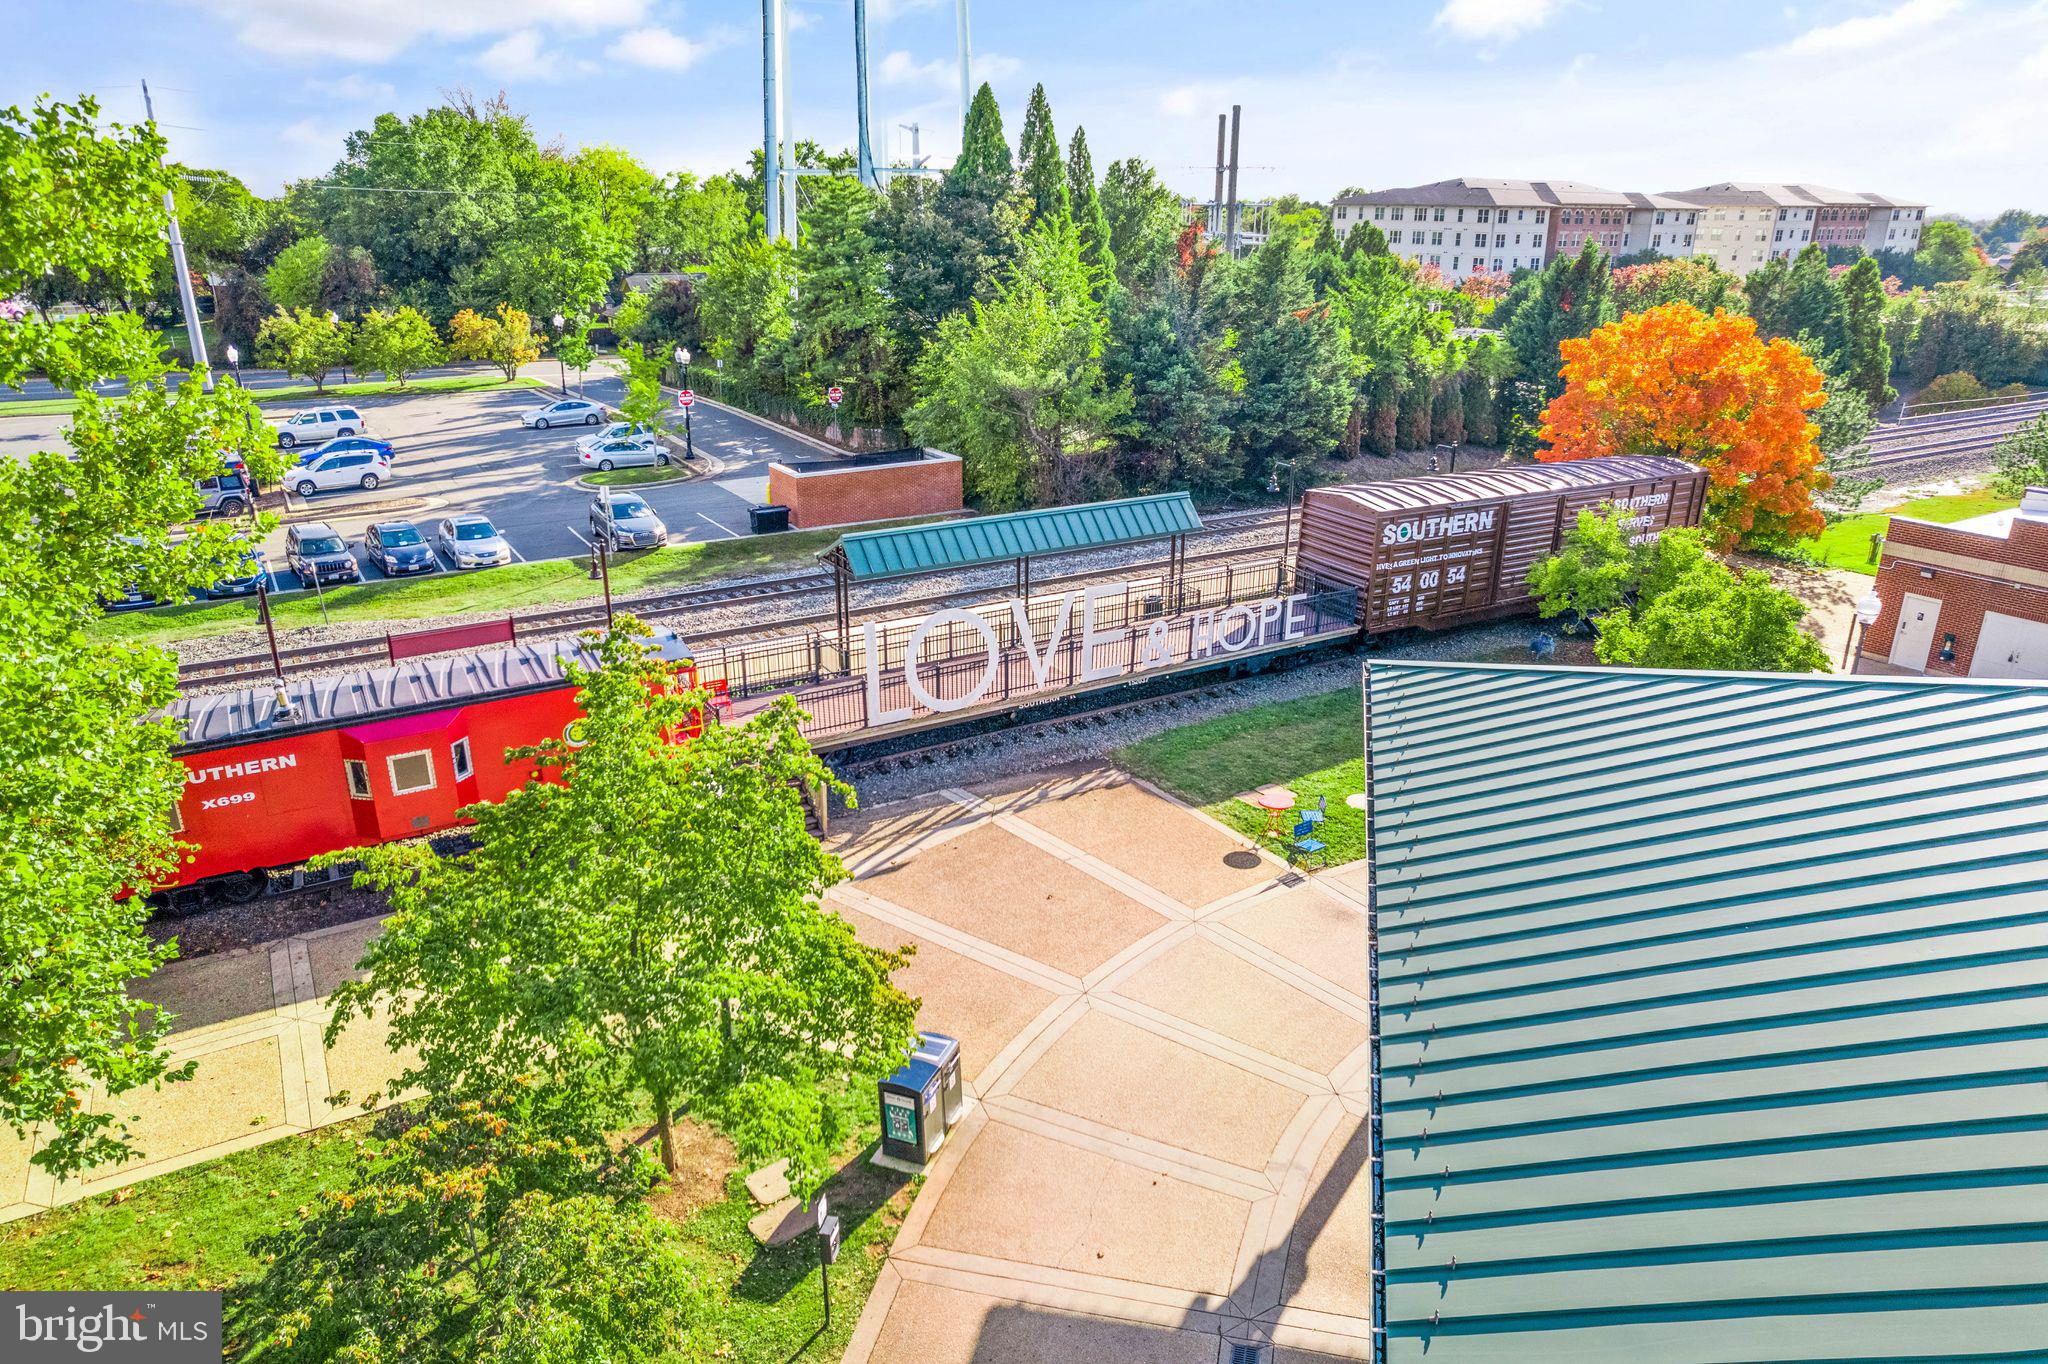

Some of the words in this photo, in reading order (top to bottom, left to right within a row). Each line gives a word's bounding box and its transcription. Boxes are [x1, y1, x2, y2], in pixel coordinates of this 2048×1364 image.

[1382, 510, 1494, 545] SOUTHERN
[1391, 574, 1412, 594] 54
[1419, 571, 1439, 589] 00
[1447, 565, 1467, 584] 54
[863, 581, 1128, 727] LOVE
[1143, 620, 1174, 668] &
[1191, 593, 1308, 660] HOPE
[185, 754, 297, 784] UTHERN
[201, 792, 256, 810] X699
